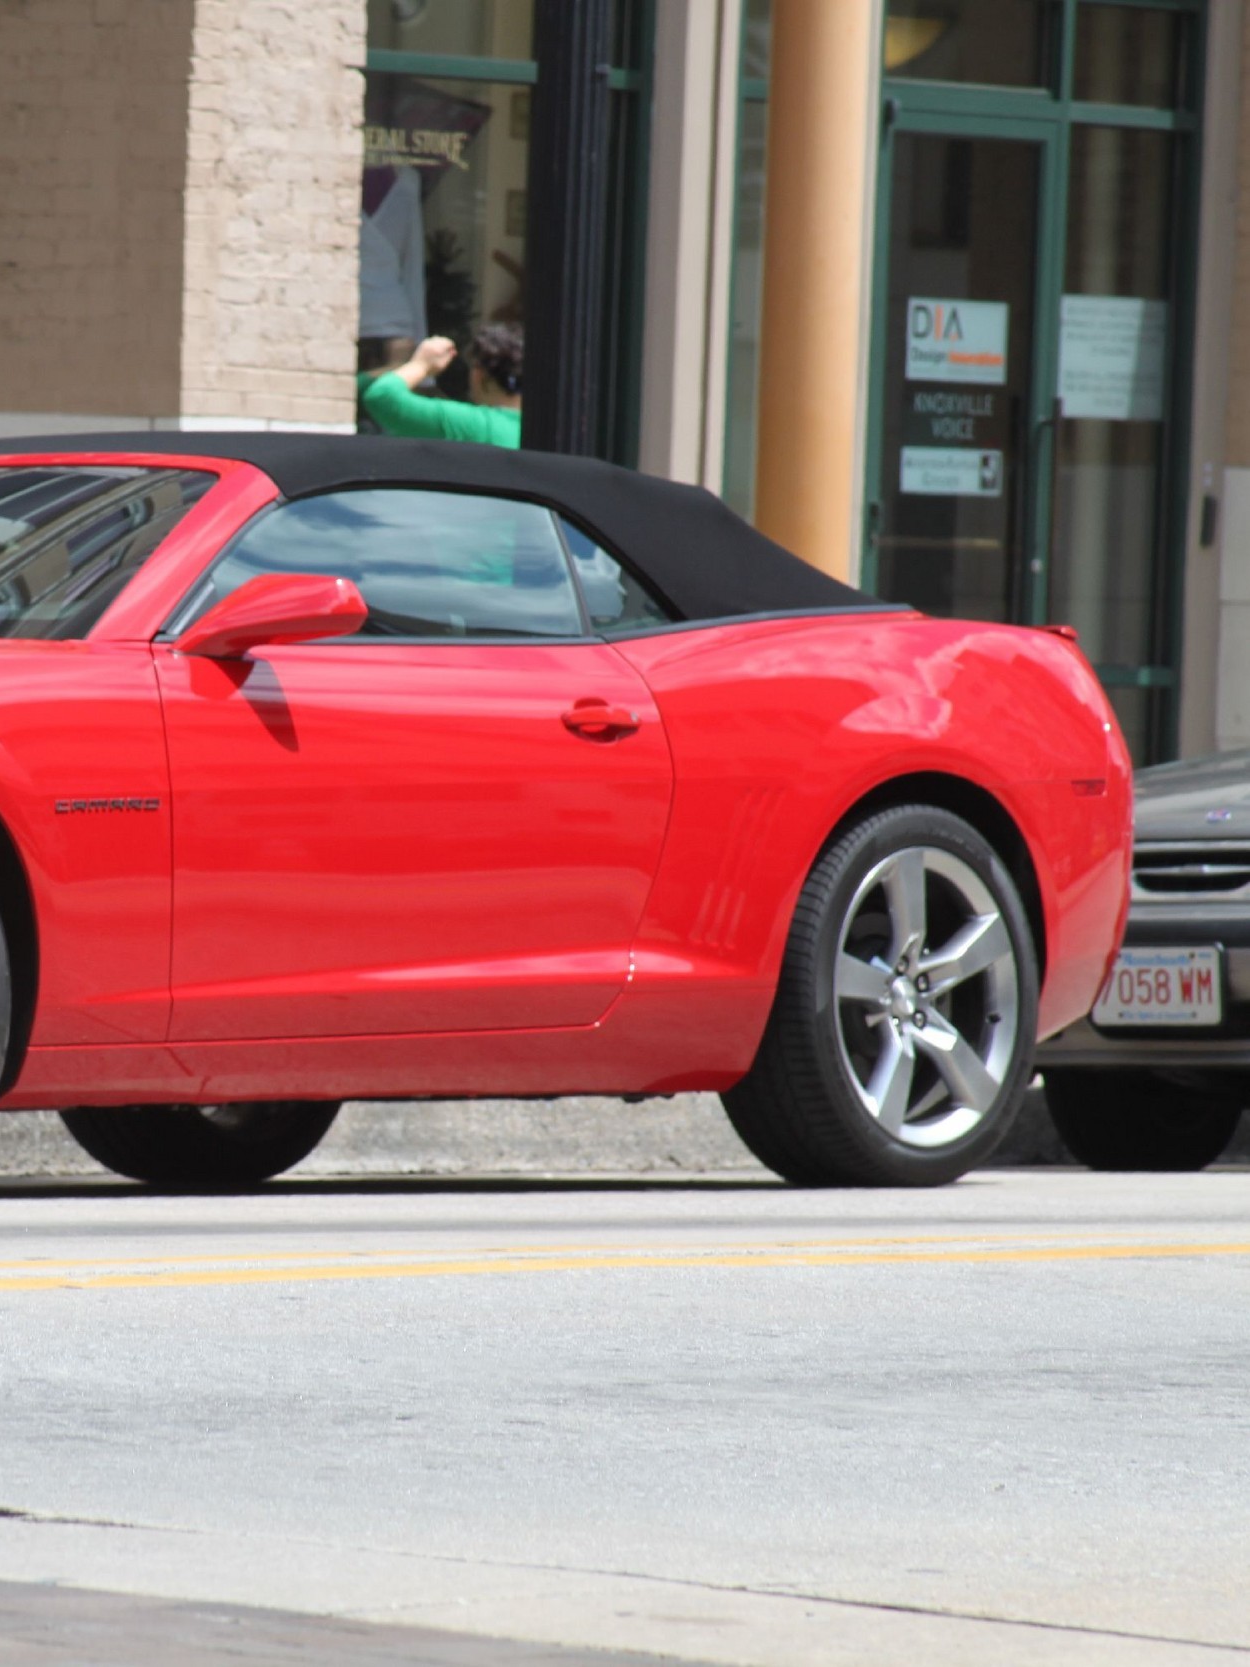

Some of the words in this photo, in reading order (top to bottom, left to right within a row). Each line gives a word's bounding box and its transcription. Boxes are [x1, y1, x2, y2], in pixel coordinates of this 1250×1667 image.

[411, 128, 469, 171] STORE
[912, 304, 964, 341] DIA
[913, 391, 993, 416] KNOXVILLE
[931, 416, 974, 440] VOICE
[55, 798, 160, 813] CAMARO
[1178, 967, 1212, 1006] WM
